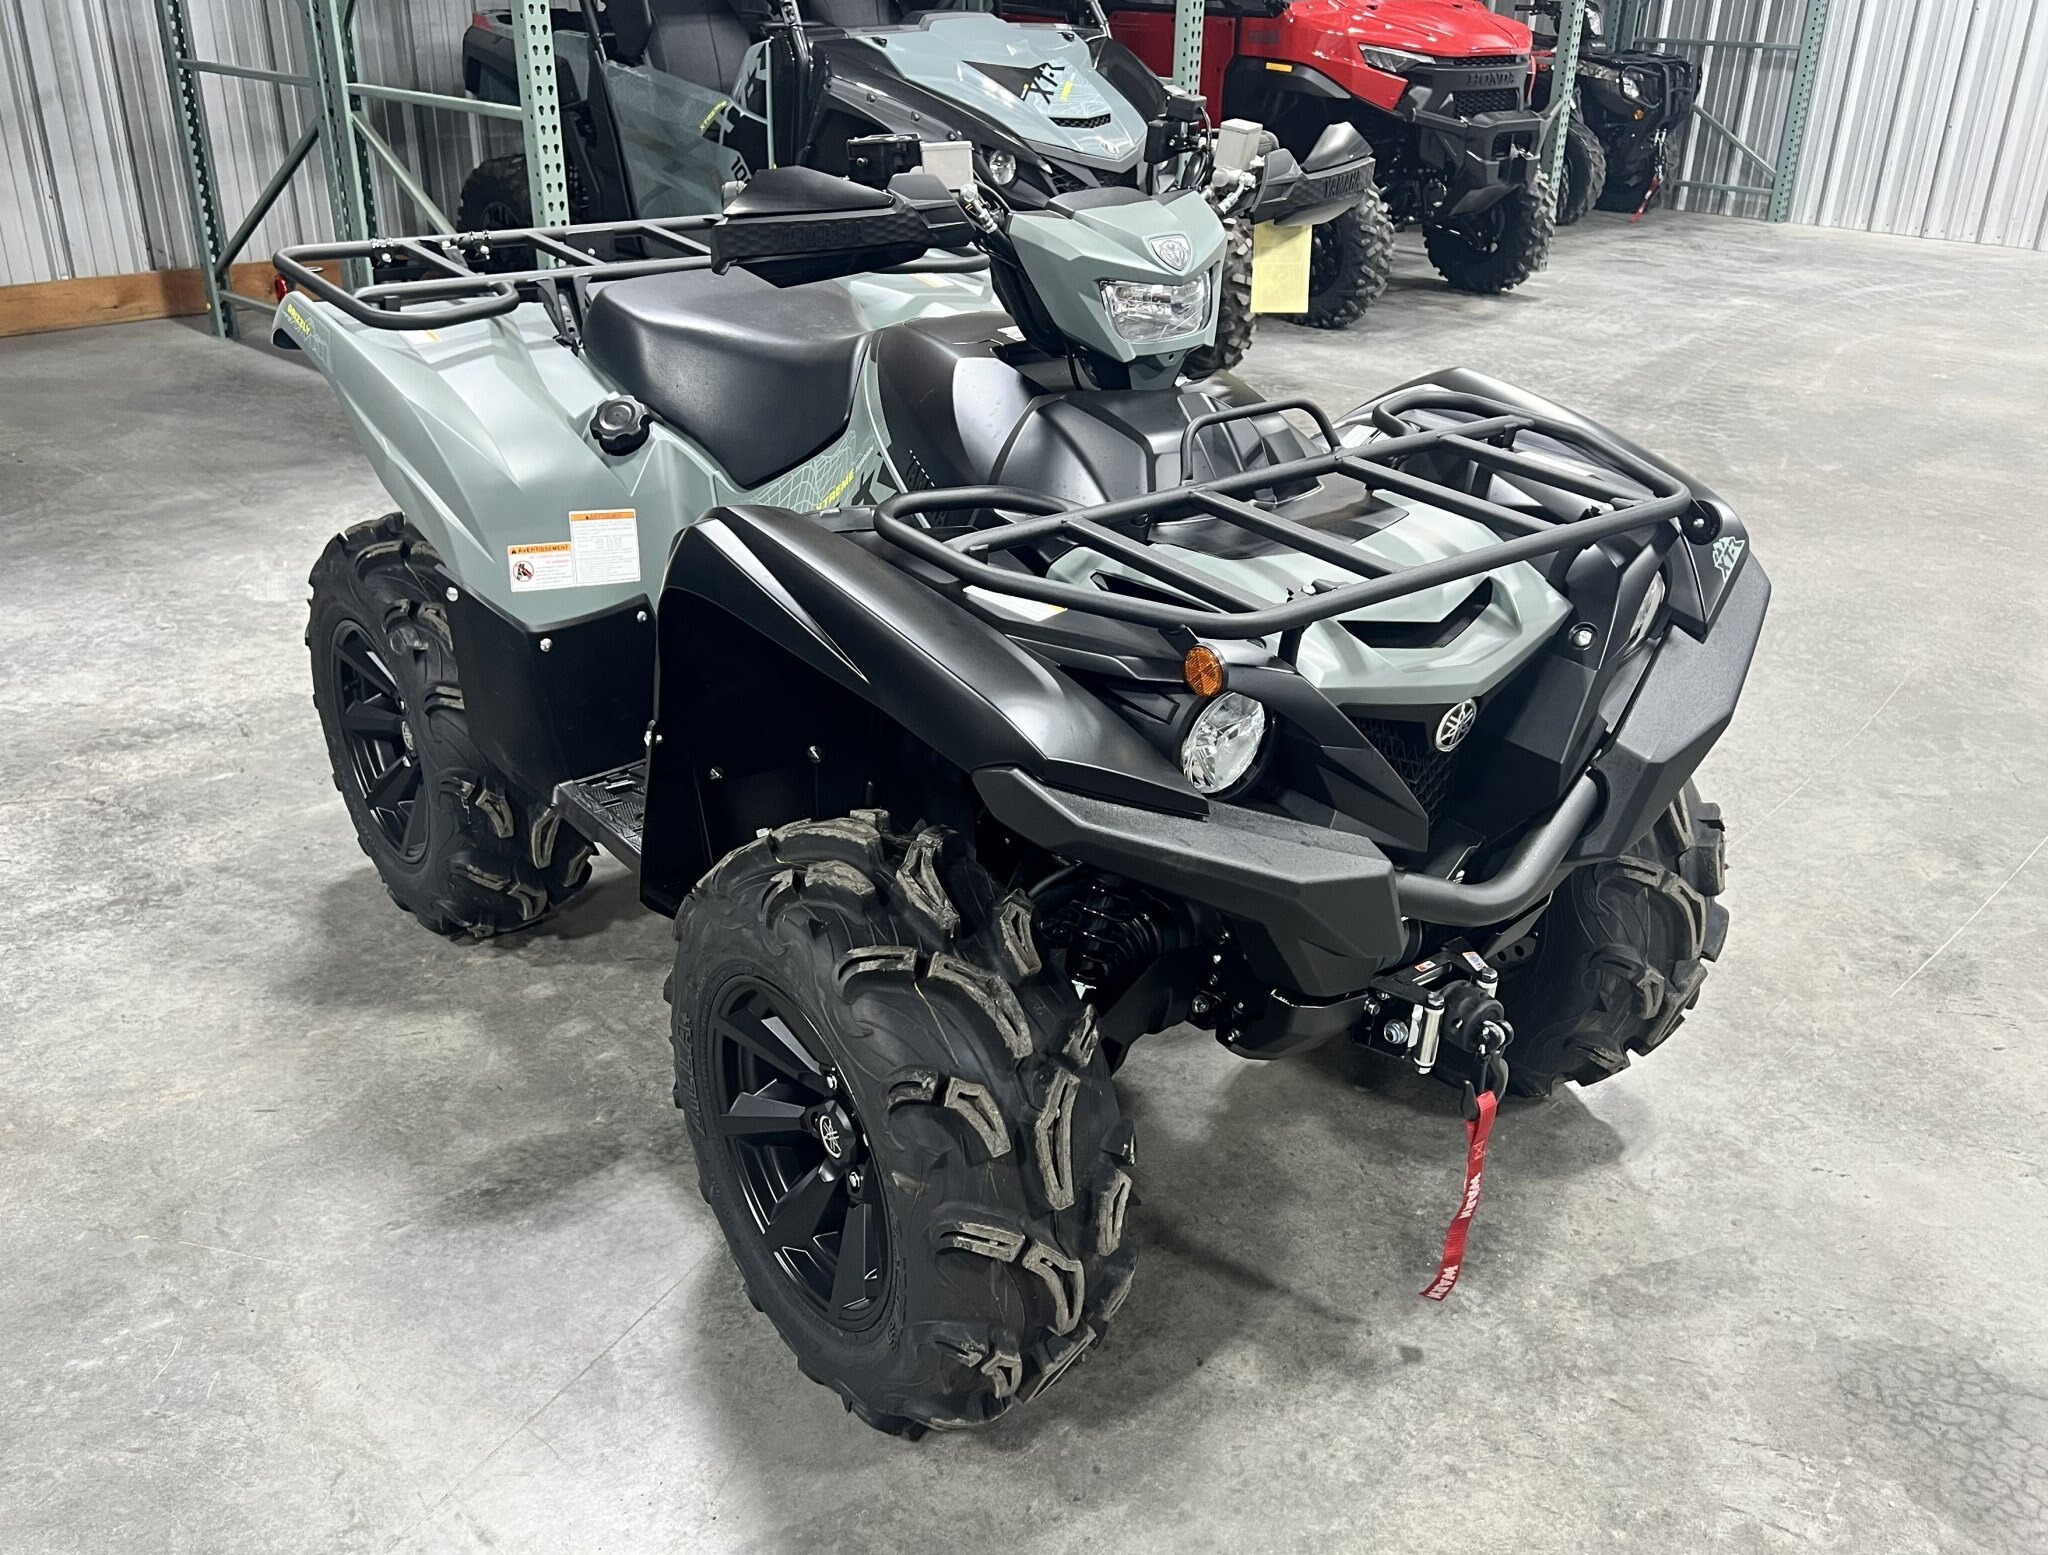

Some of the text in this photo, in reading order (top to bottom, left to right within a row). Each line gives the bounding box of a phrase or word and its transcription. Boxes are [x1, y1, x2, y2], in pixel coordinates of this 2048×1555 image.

[1467, 71, 1515, 87] HONDA
[1324, 170, 1361, 198] YAMAHA
[286, 302, 312, 336] GRIZZLY
[518, 544, 569, 554] AVERTISSEMENT
[676, 1024, 707, 1138] ZILLA
[1458, 1171, 1482, 1220] WARN
[1426, 1264, 1459, 1300] WARN
